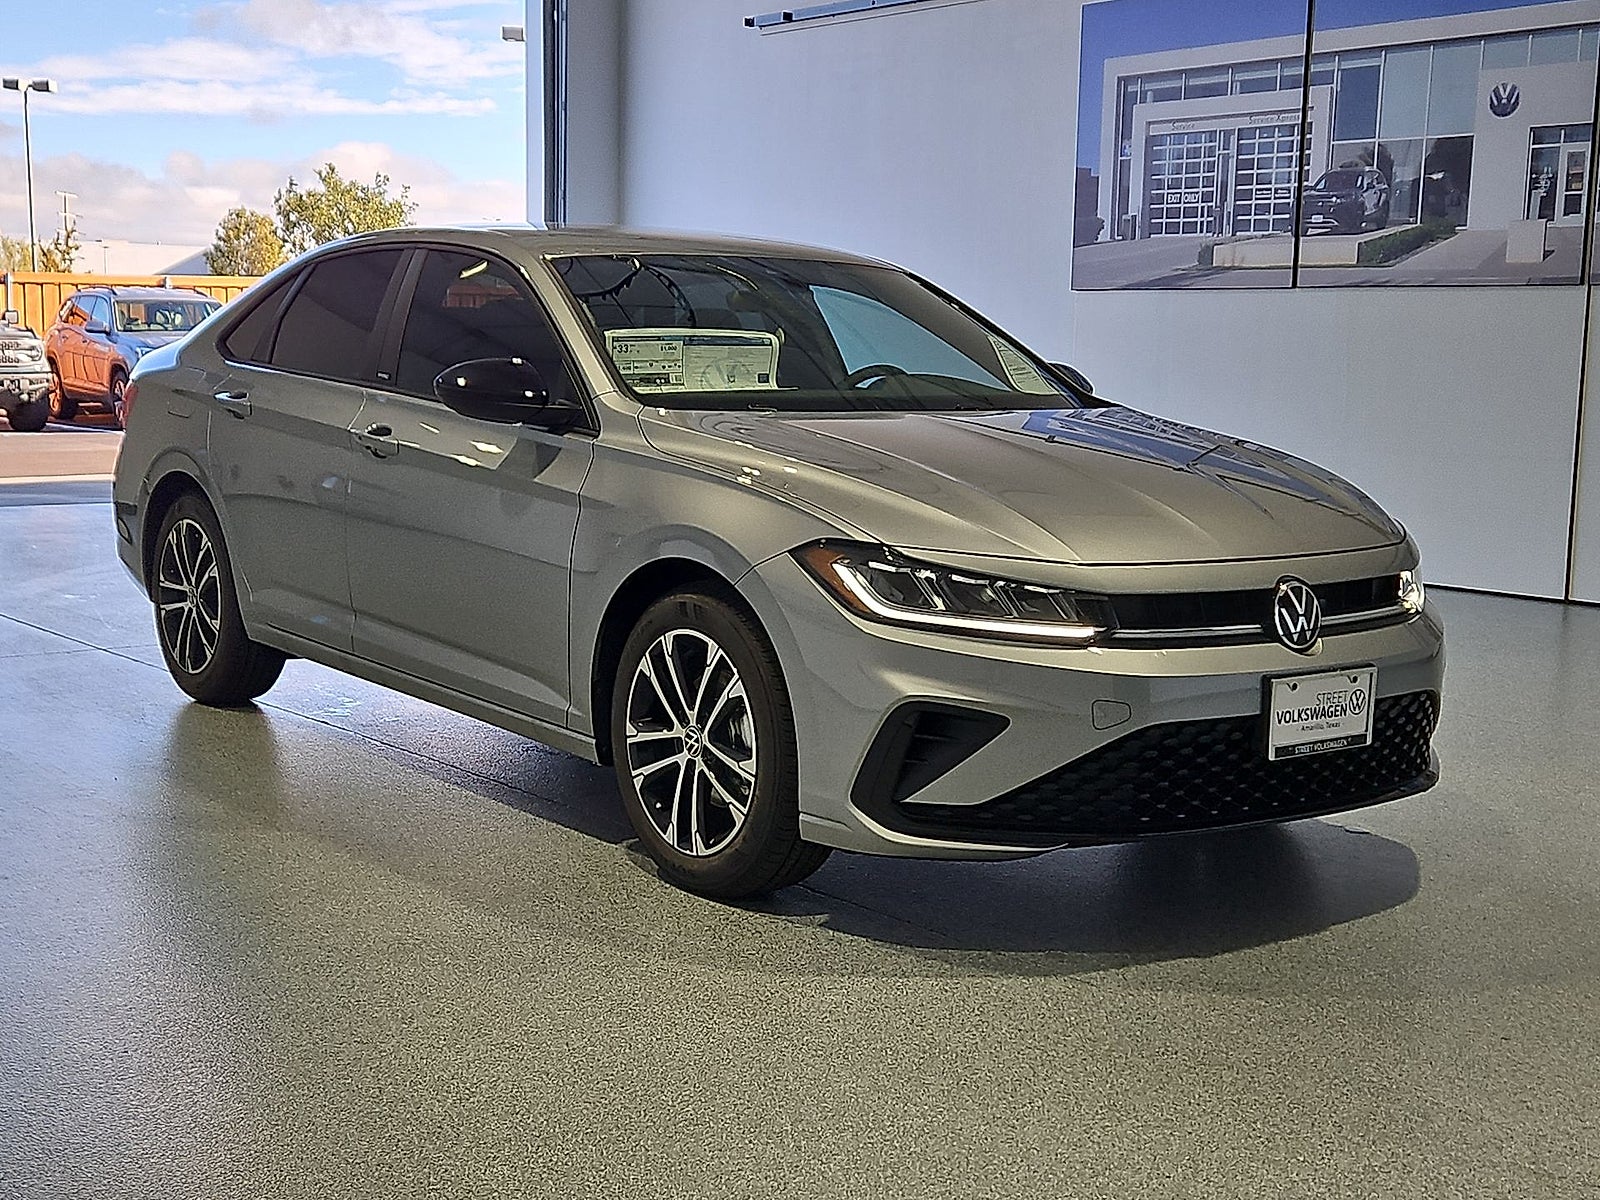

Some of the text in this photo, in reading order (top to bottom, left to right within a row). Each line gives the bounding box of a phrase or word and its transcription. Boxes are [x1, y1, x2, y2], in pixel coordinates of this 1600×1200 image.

[1167, 193, 1181, 203] EXIT
[617, 344, 629, 353] 33
[1316, 690, 1349, 706] STREET
[1276, 703, 1348, 725] VOLKSWAGEN
